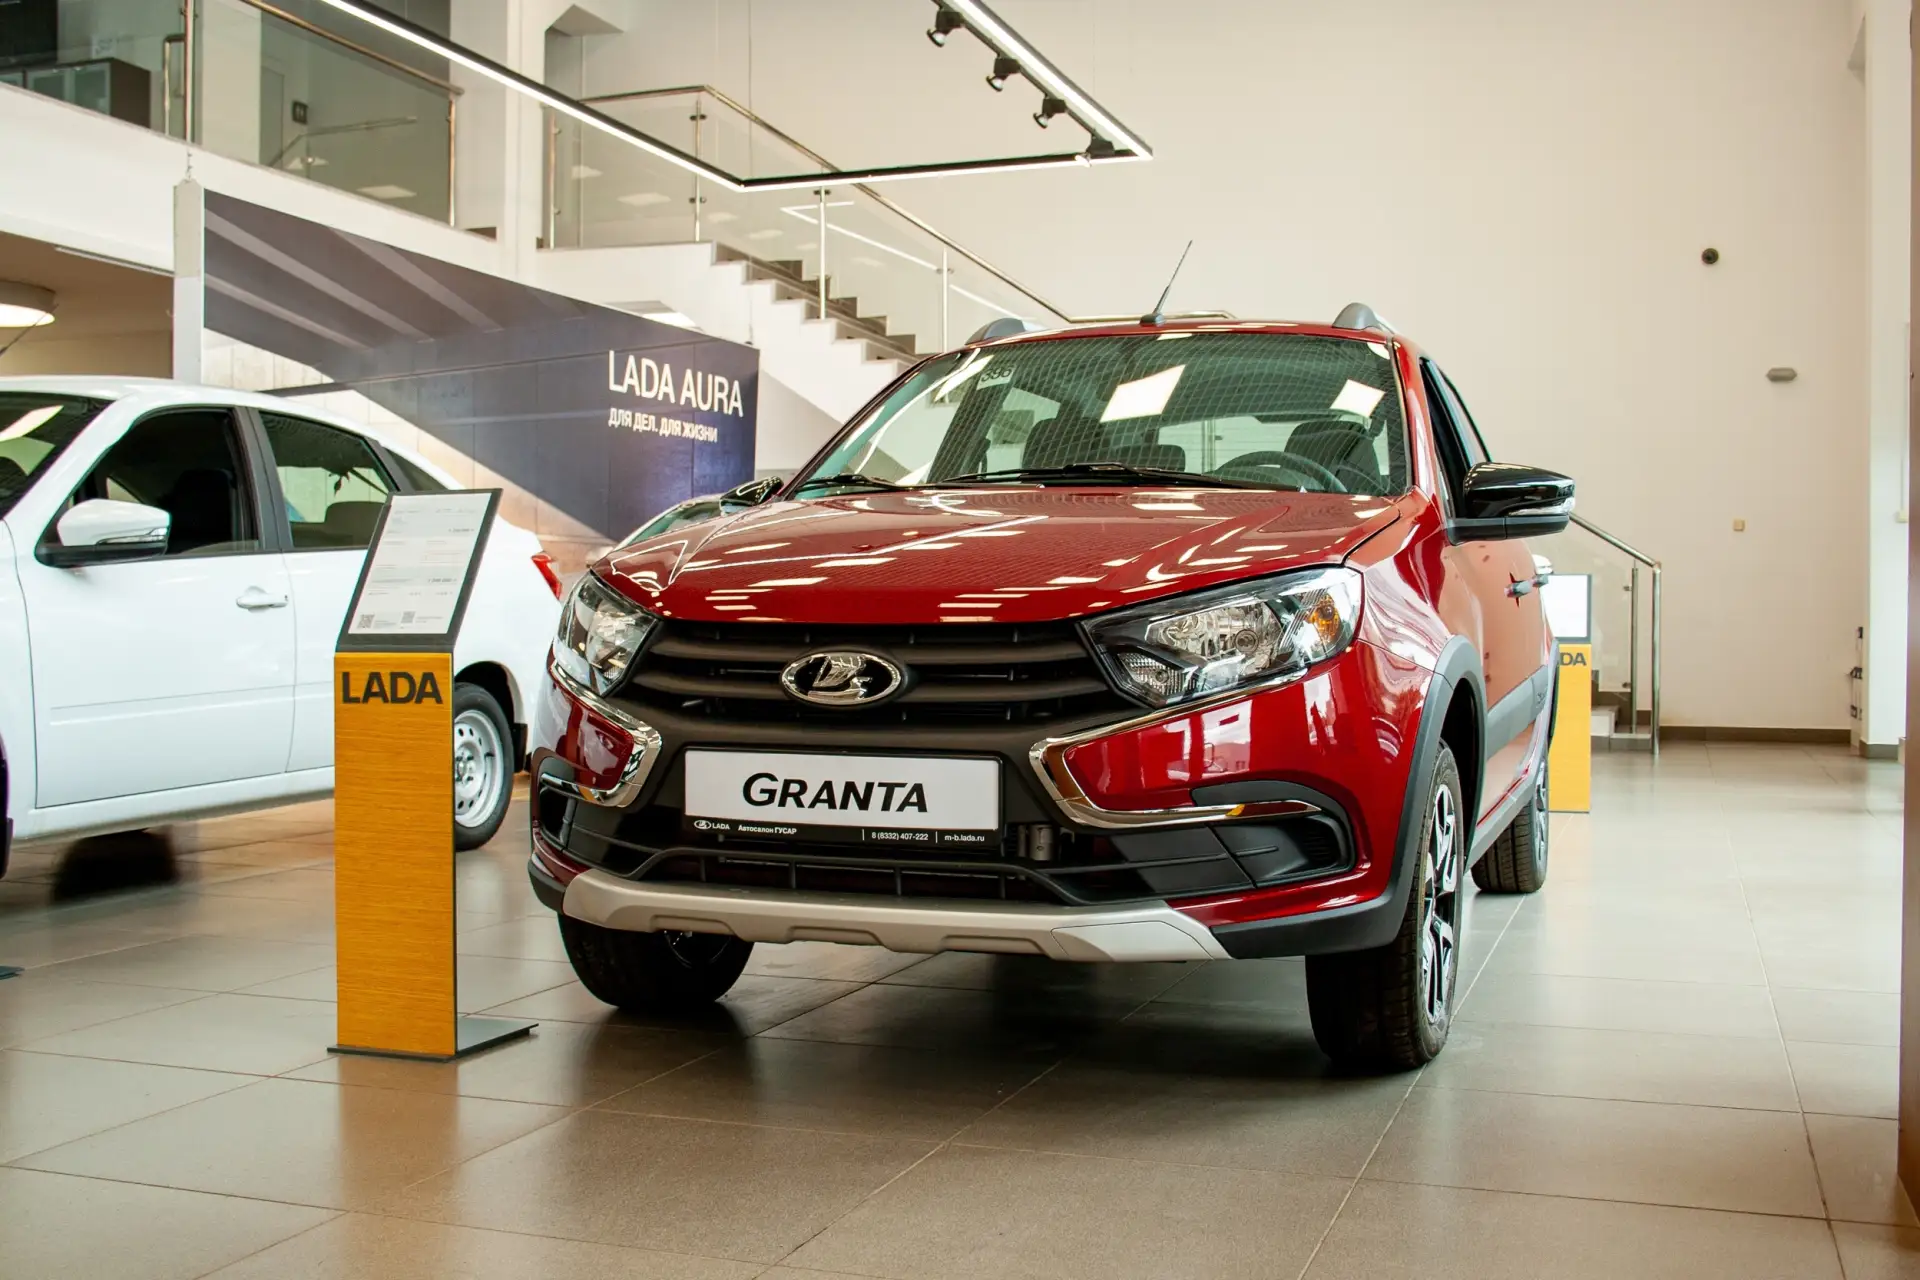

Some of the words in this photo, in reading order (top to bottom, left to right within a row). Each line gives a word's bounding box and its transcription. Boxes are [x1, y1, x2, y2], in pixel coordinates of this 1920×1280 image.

[609, 350, 675, 404] LADA
[680, 368, 744, 418] AURA
[608, 408, 632, 428] ДЛЯ
[633, 412, 658, 433] ДЕЛ.
[659, 417, 682, 437] ДЛЯ
[682, 421, 718, 442] ЖИЗНИ
[1560, 652, 1587, 666] DA
[341, 671, 443, 704] LADA
[742, 772, 928, 813] GRANTA
[738, 825, 774, 834] Автосалон
[774, 827, 797, 835] ГУСАР
[871, 831, 877, 839] 8
[877, 831, 900, 840] (8332)
[900, 832, 929, 841] 407-222
[944, 834, 985, 842] m-b.lada.ru
